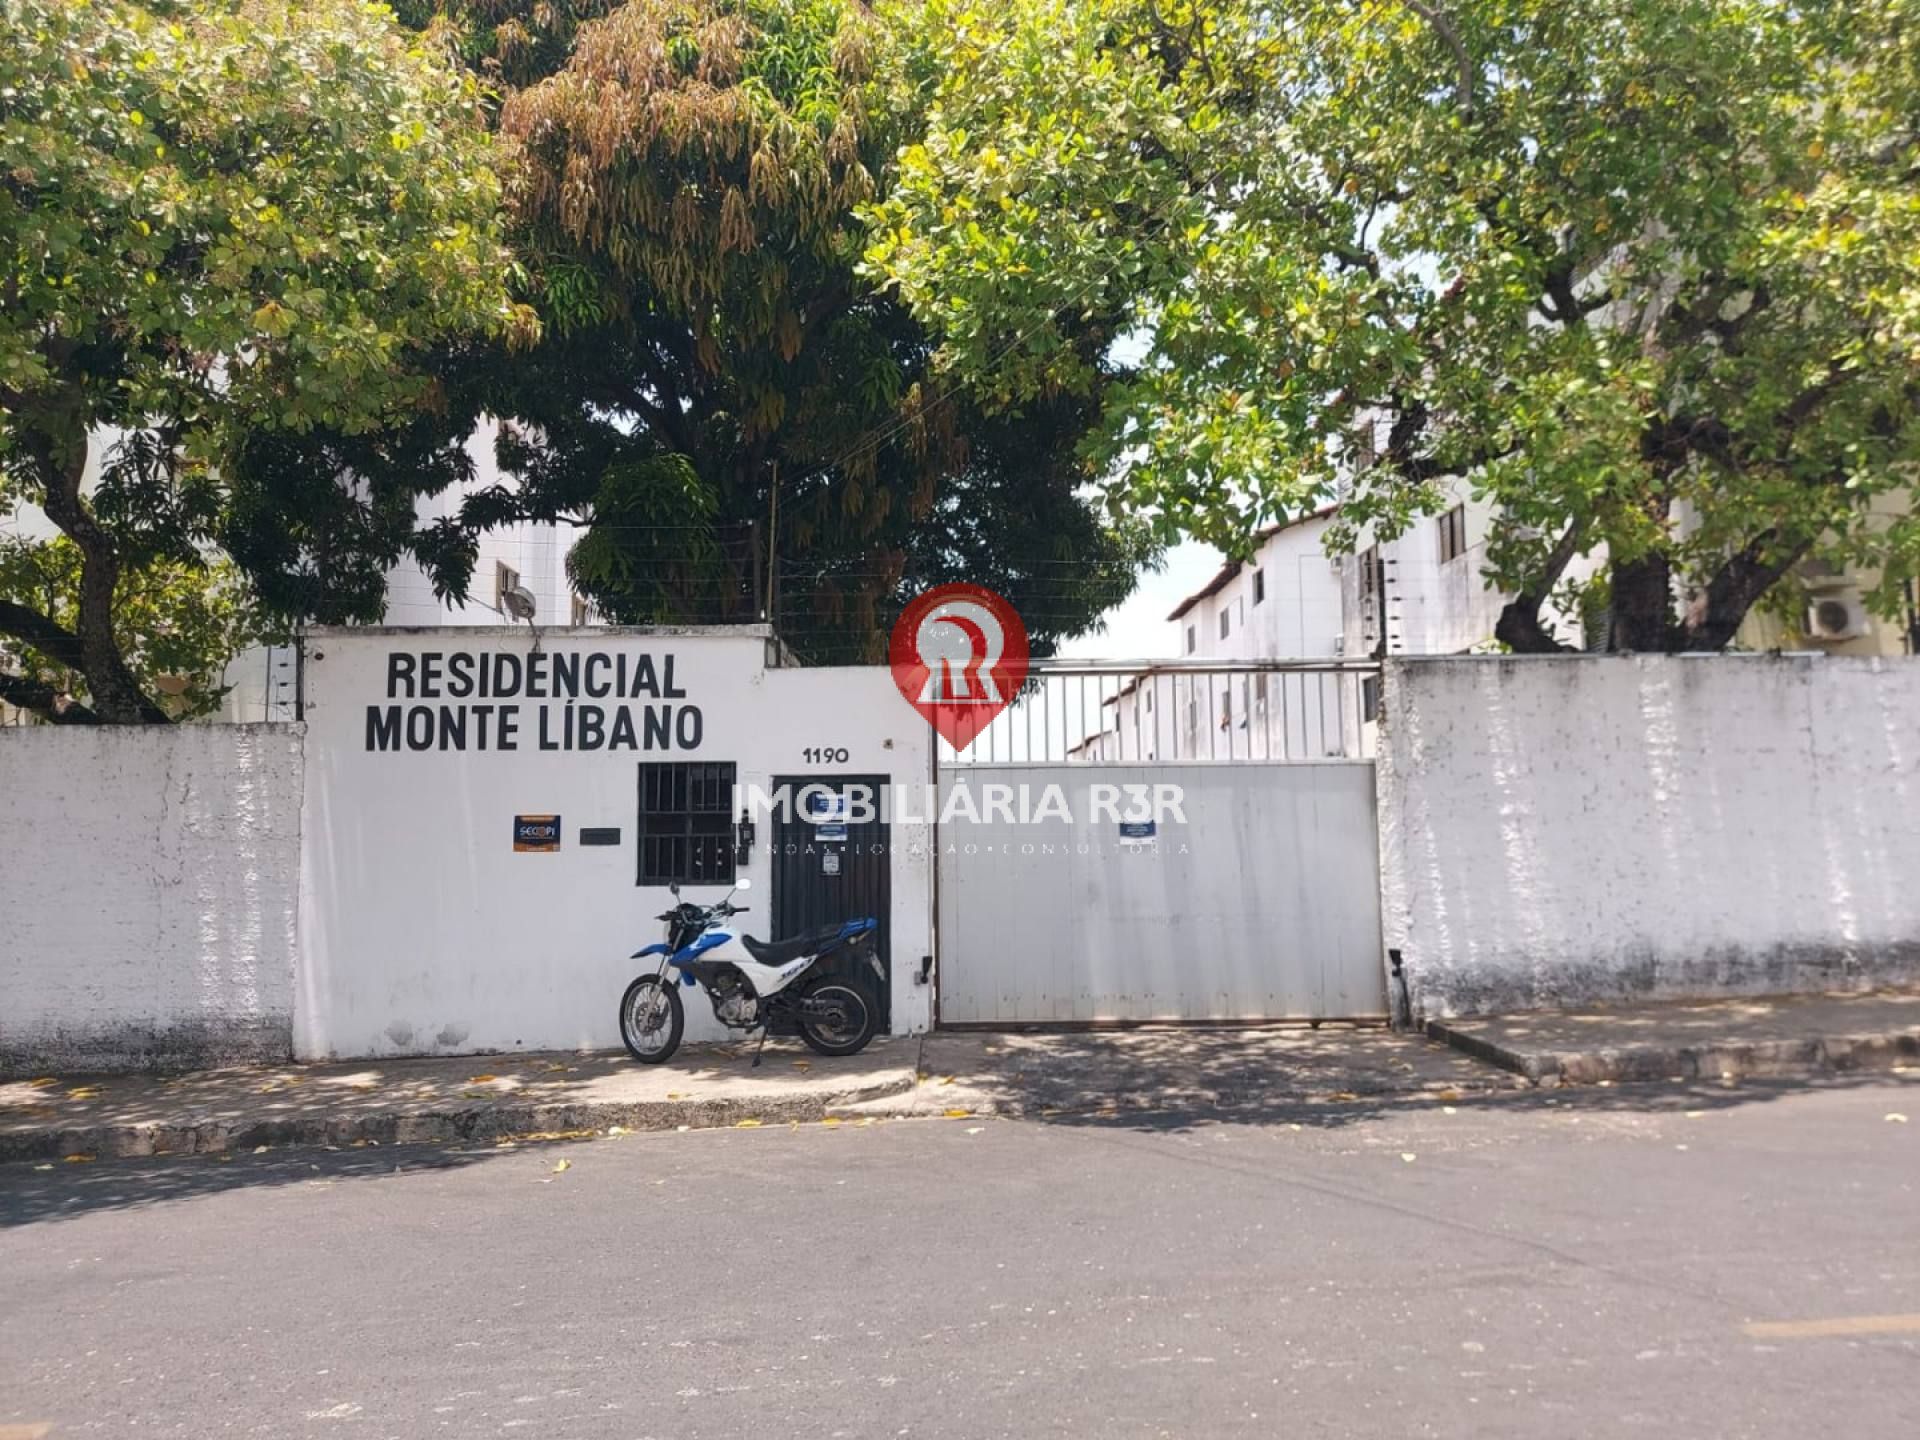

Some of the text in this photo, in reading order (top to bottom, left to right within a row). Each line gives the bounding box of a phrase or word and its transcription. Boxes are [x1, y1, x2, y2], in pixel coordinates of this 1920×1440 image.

[387, 652, 686, 698] RESIDENCIAL
[365, 699, 703, 751] MONTE LÍBANO
[803, 748, 849, 763] 1190
